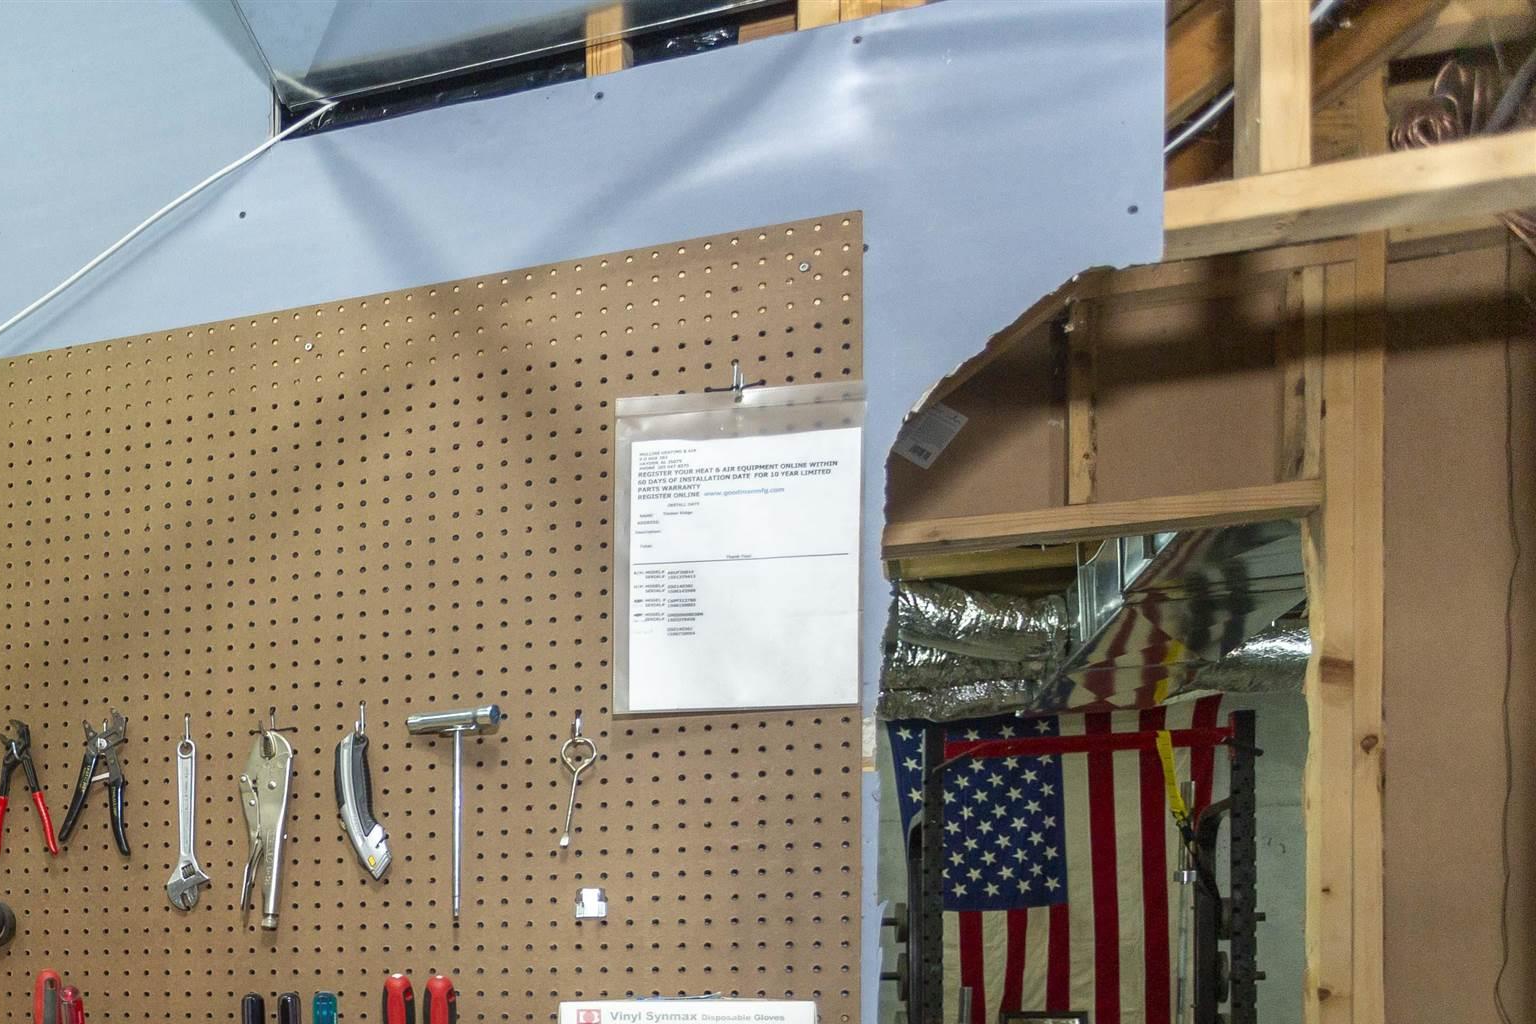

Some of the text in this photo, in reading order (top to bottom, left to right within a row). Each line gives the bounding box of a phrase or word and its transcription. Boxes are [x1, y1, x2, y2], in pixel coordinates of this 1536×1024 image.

[638, 469, 672, 478] REGISTER
[674, 468, 694, 476] YOUR
[695, 467, 713, 475] HEAT
[737, 463, 779, 472] EQUIPMENT
[781, 462, 807, 470] ONLINE
[809, 460, 838, 468] WITHIN
[648, 478, 667, 486] DAYS
[679, 474, 731, 483] INSTALLATION
[781, 469, 799, 477] YEAR
[801, 468, 831, 476] LIMITED
[662, 484, 701, 492] WARRANTY
[673, 491, 700, 499] ONLINE
[610, 1011, 785, 1023] Vinyl Synmax Disposable Gloves
